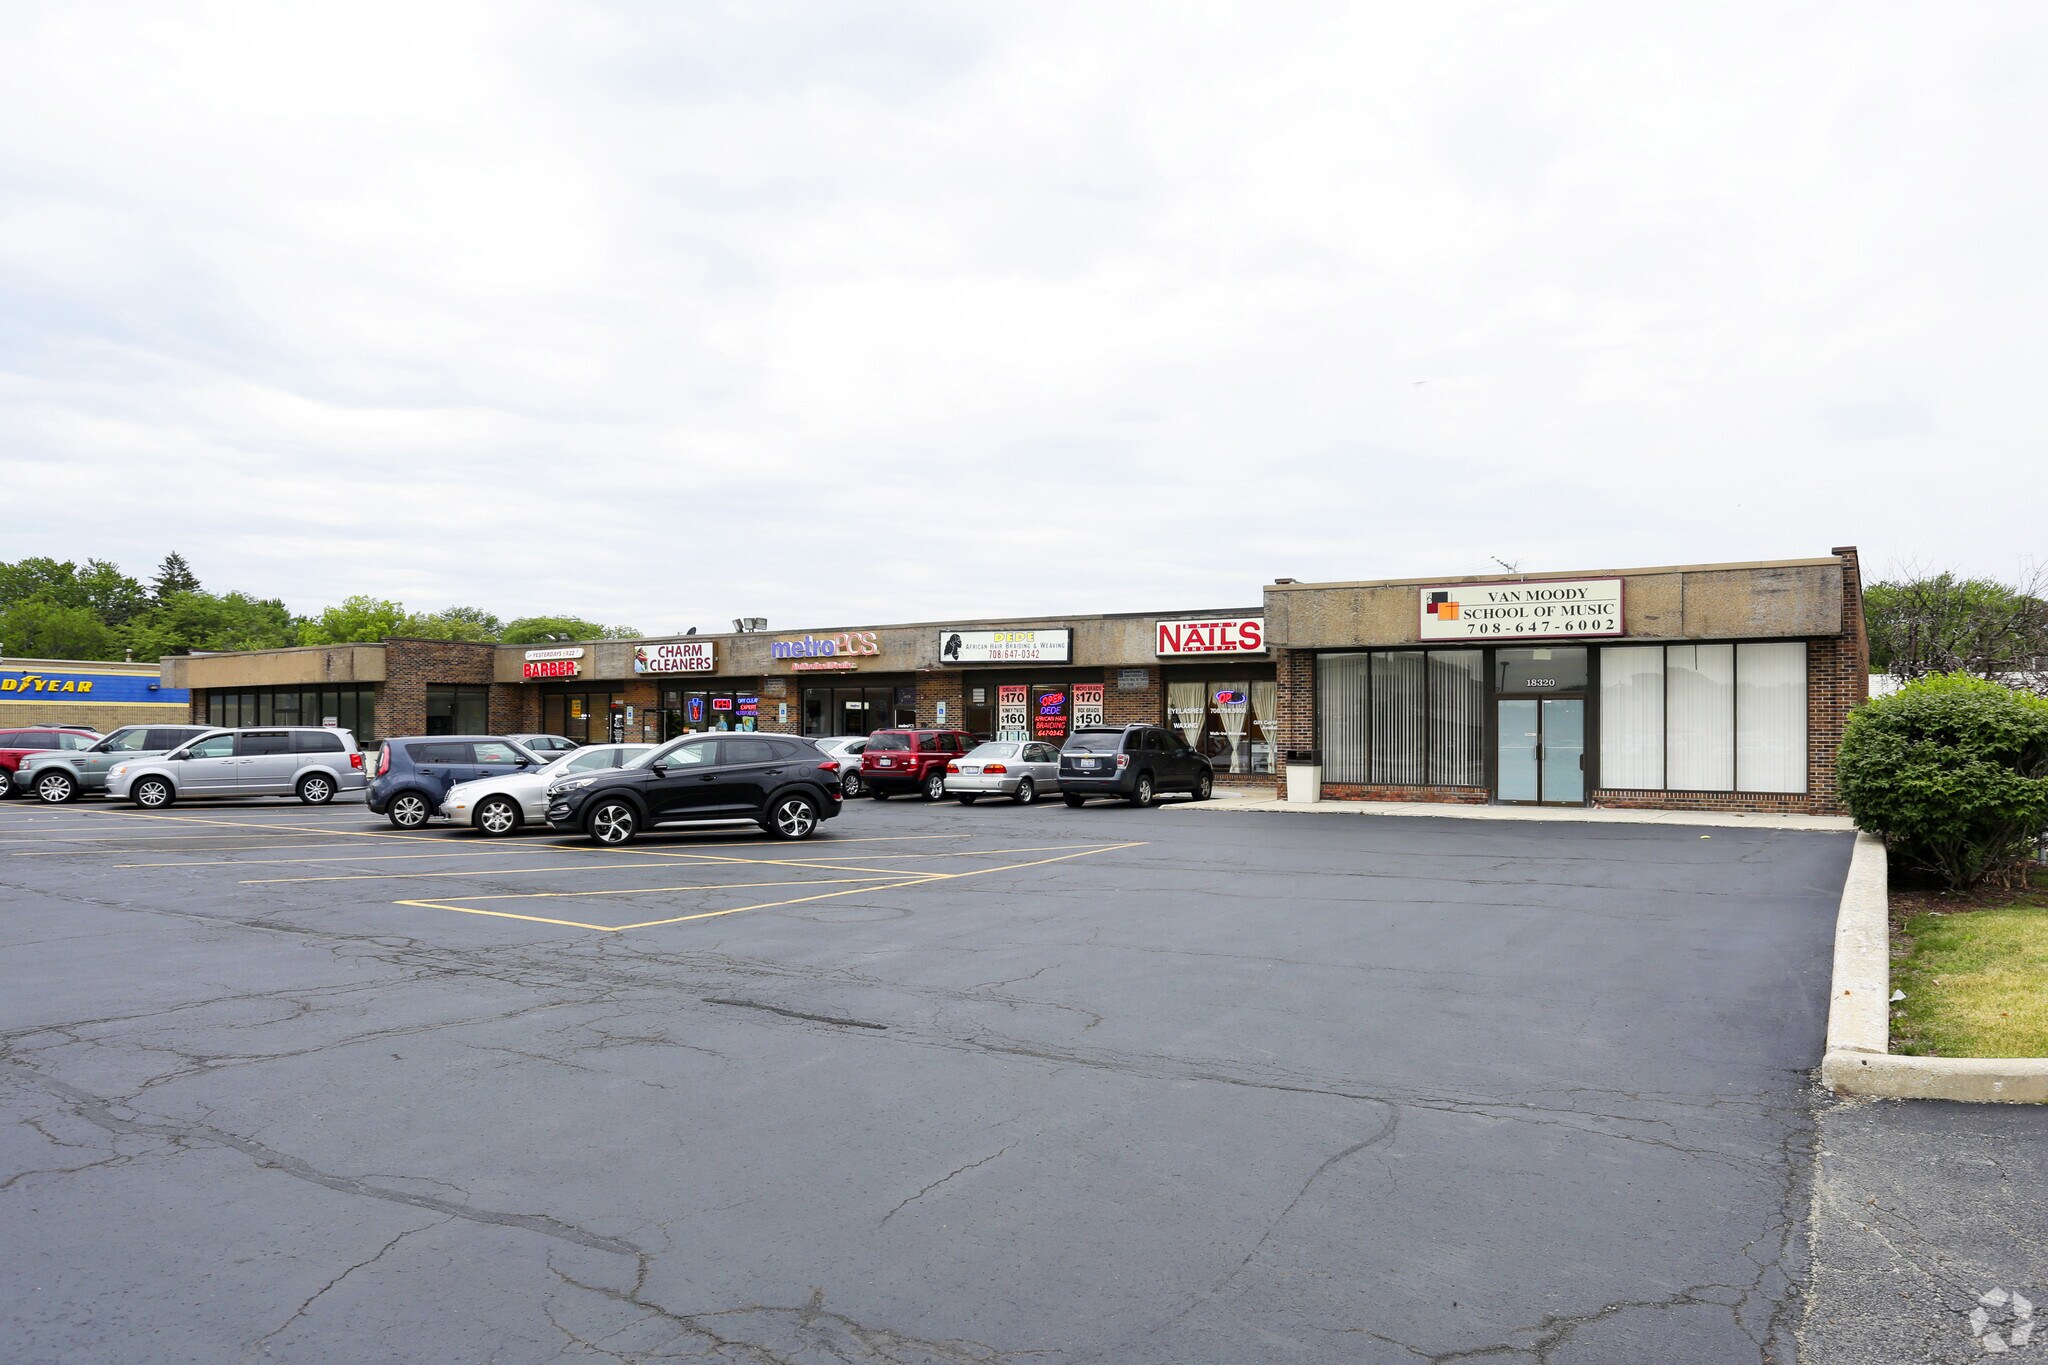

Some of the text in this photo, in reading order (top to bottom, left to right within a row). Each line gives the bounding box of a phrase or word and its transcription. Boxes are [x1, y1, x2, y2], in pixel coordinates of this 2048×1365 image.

[1488, 588, 1589, 602] VAN MOODY
[1464, 603, 1615, 620] SCHOOL OF MUSIC
[1467, 618, 1615, 634] 708-647-6002
[994, 632, 1034, 643] DEDE
[1160, 621, 1261, 652] NAILS
[658, 644, 702, 658] CHARM
[771, 631, 878, 658] metroPCS
[989, 650, 1040, 659] 708/647-0342
[523, 661, 575, 678] BARBER
[650, 657, 711, 671] CLEANERS
[1526, 679, 1555, 687] 18320
[1001, 693, 1025, 703] $170
[1042, 693, 1063, 706] OPEN
[1076, 692, 1101, 702] $170
[1041, 706, 1061, 714] DEDE
[1001, 714, 1025, 724] $160
[1076, 713, 1101, 724] $150
